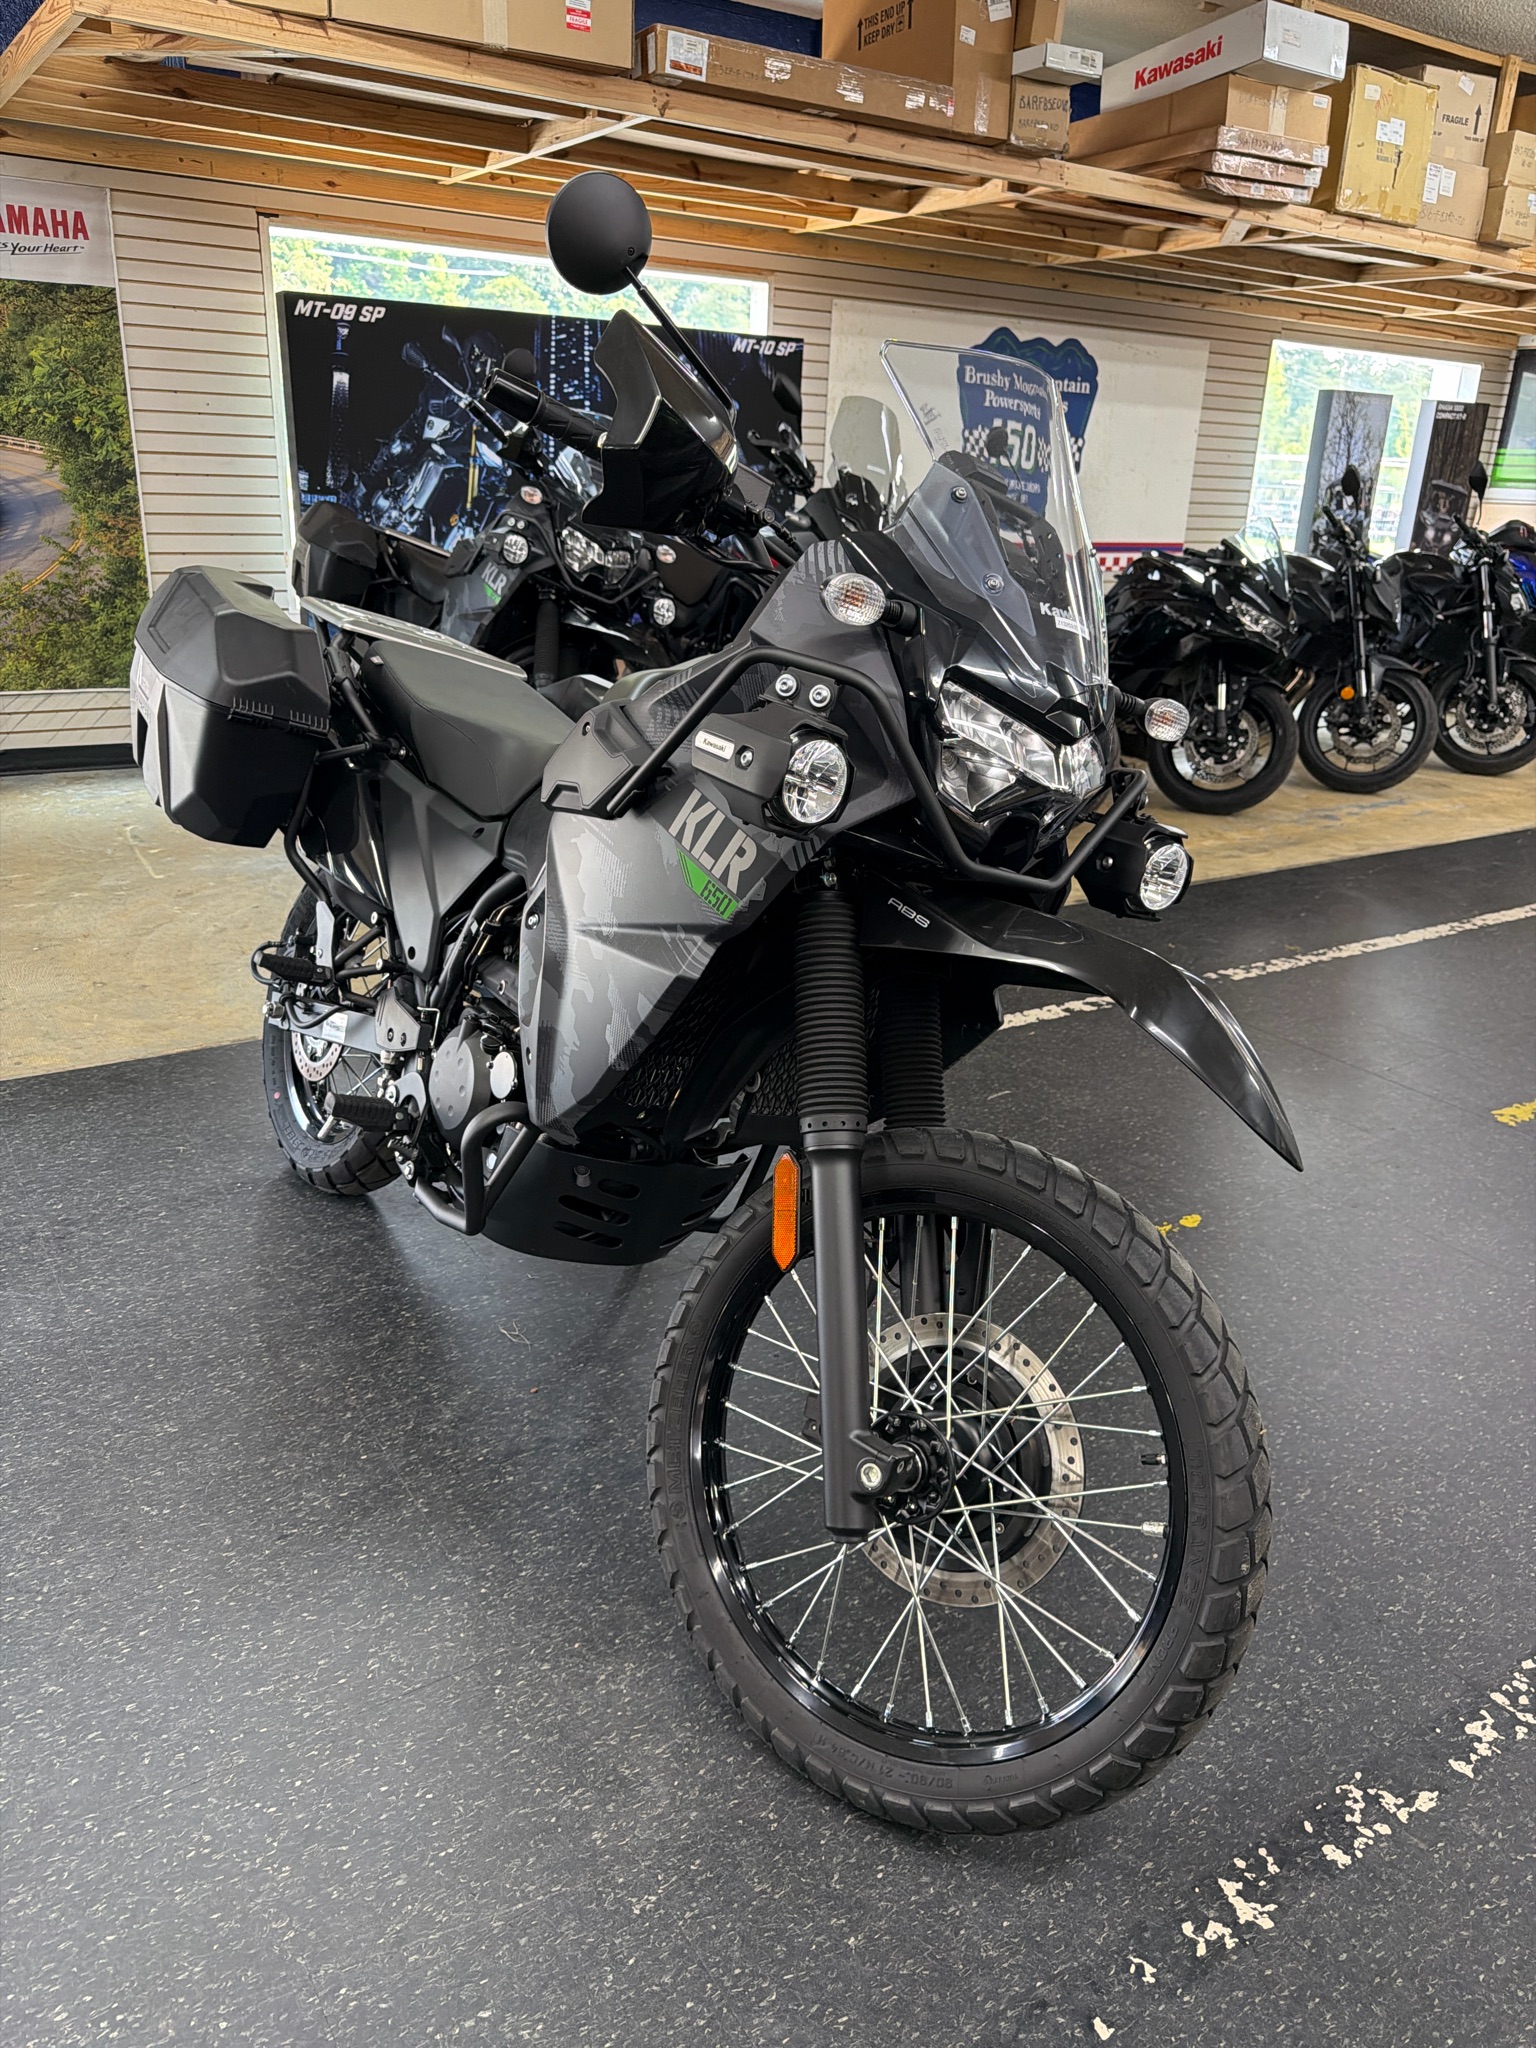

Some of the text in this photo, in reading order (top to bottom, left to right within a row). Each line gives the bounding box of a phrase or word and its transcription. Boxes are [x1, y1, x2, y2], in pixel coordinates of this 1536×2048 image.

[864, 2, 906, 30] THIS END UP
[863, 23, 896, 47] KEEP DRY
[1134, 34, 1223, 90] Kawasaki
[1441, 113, 1469, 126] FRAGILE
[11, 241, 43, 255] Your
[43, 243, 80, 253] Heart
[294, 299, 387, 323] MT-09 SP
[732, 336, 797, 357] MT-10 SP
[964, 365, 1091, 401] Brushy Montain
[481, 561, 507, 596] KLR
[702, 737, 727, 753] Kawasaki
[668, 788, 758, 895] KLR
[700, 879, 733, 916] 650
[887, 897, 930, 928] ABS
[667, 1342, 698, 1495] METZELER
[1177, 1448, 1207, 1615] TOURANCE
[1142, 1623, 1179, 1687] FRONT
